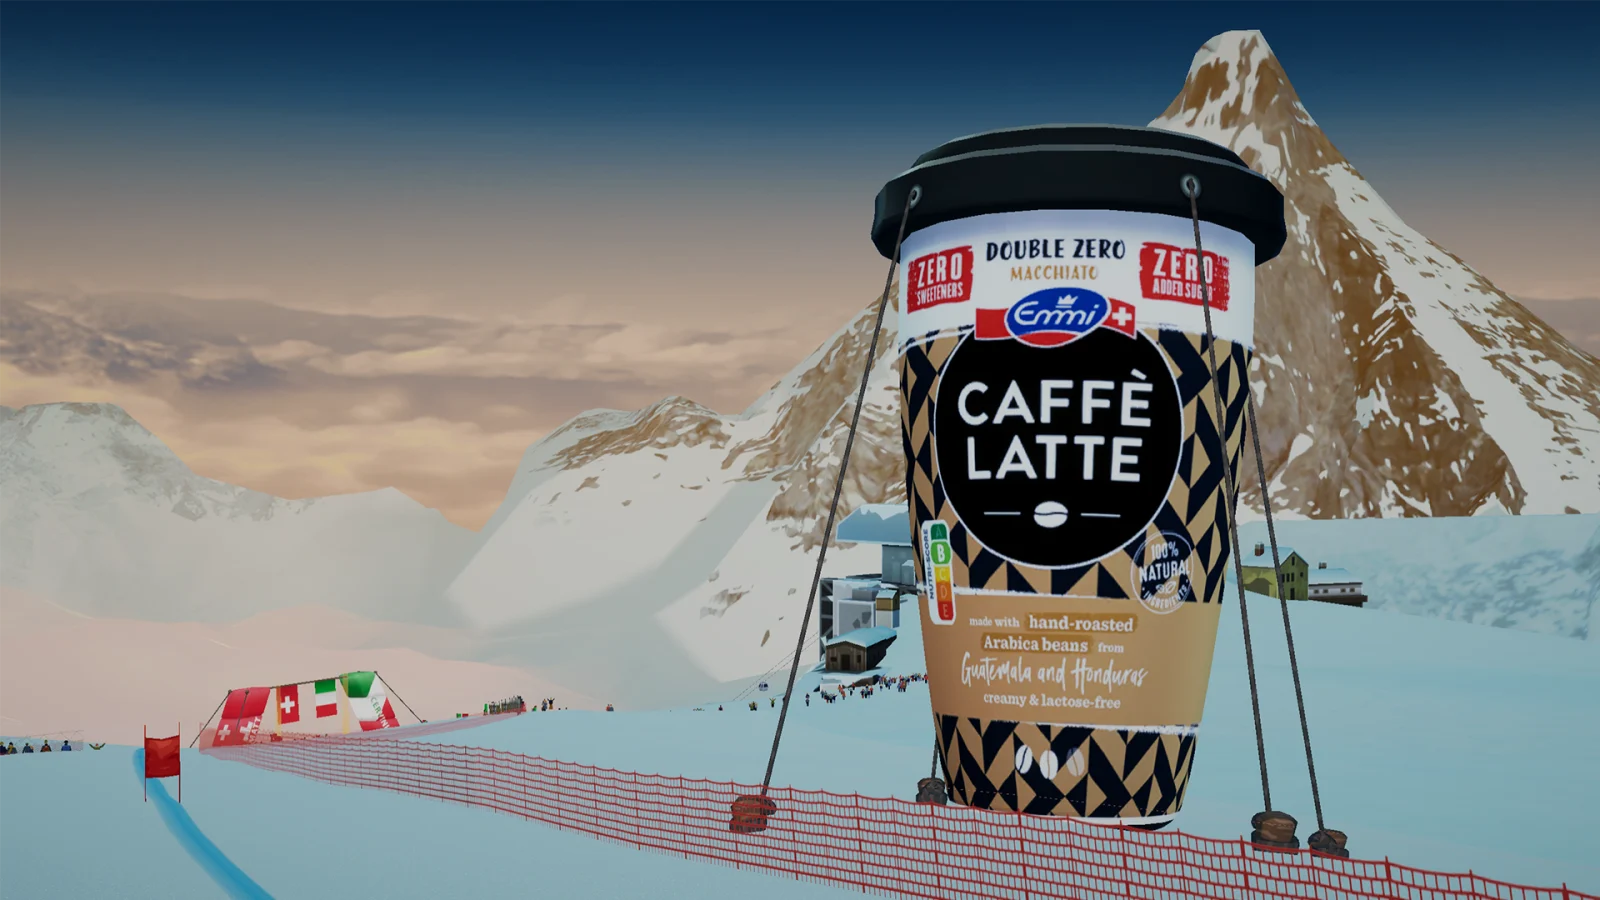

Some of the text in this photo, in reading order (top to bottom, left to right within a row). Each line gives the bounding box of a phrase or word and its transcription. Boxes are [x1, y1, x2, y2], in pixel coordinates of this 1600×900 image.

[986, 239, 1126, 261] DOUBLE ZERO
[917, 252, 963, 289] ZERO
[1010, 265, 1098, 281] MACCHIATO
[1152, 248, 1213, 284] ZERO
[917, 281, 963, 306] SWEETENERS
[1152, 278, 1213, 302] ADDED SUGR
[1014, 301, 1100, 326] Emmi
[957, 368, 1153, 427] CAFFÈ
[967, 434, 1143, 482] LATTE
[937, 543, 946, 562] B
[1151, 541, 1179, 560] 100%
[923, 529, 935, 600] NUTRI-SCORE
[939, 568, 946, 580] C
[1139, 559, 1190, 583] NATURAL
[940, 585, 948, 599] D
[943, 604, 949, 618] E
[969, 615, 1134, 632] made with hand-roasted
[984, 635, 1124, 653] Arabica beans from
[961, 651, 1149, 695] Guatemala and Honduras
[983, 693, 1121, 709] creamy & lactose-free
